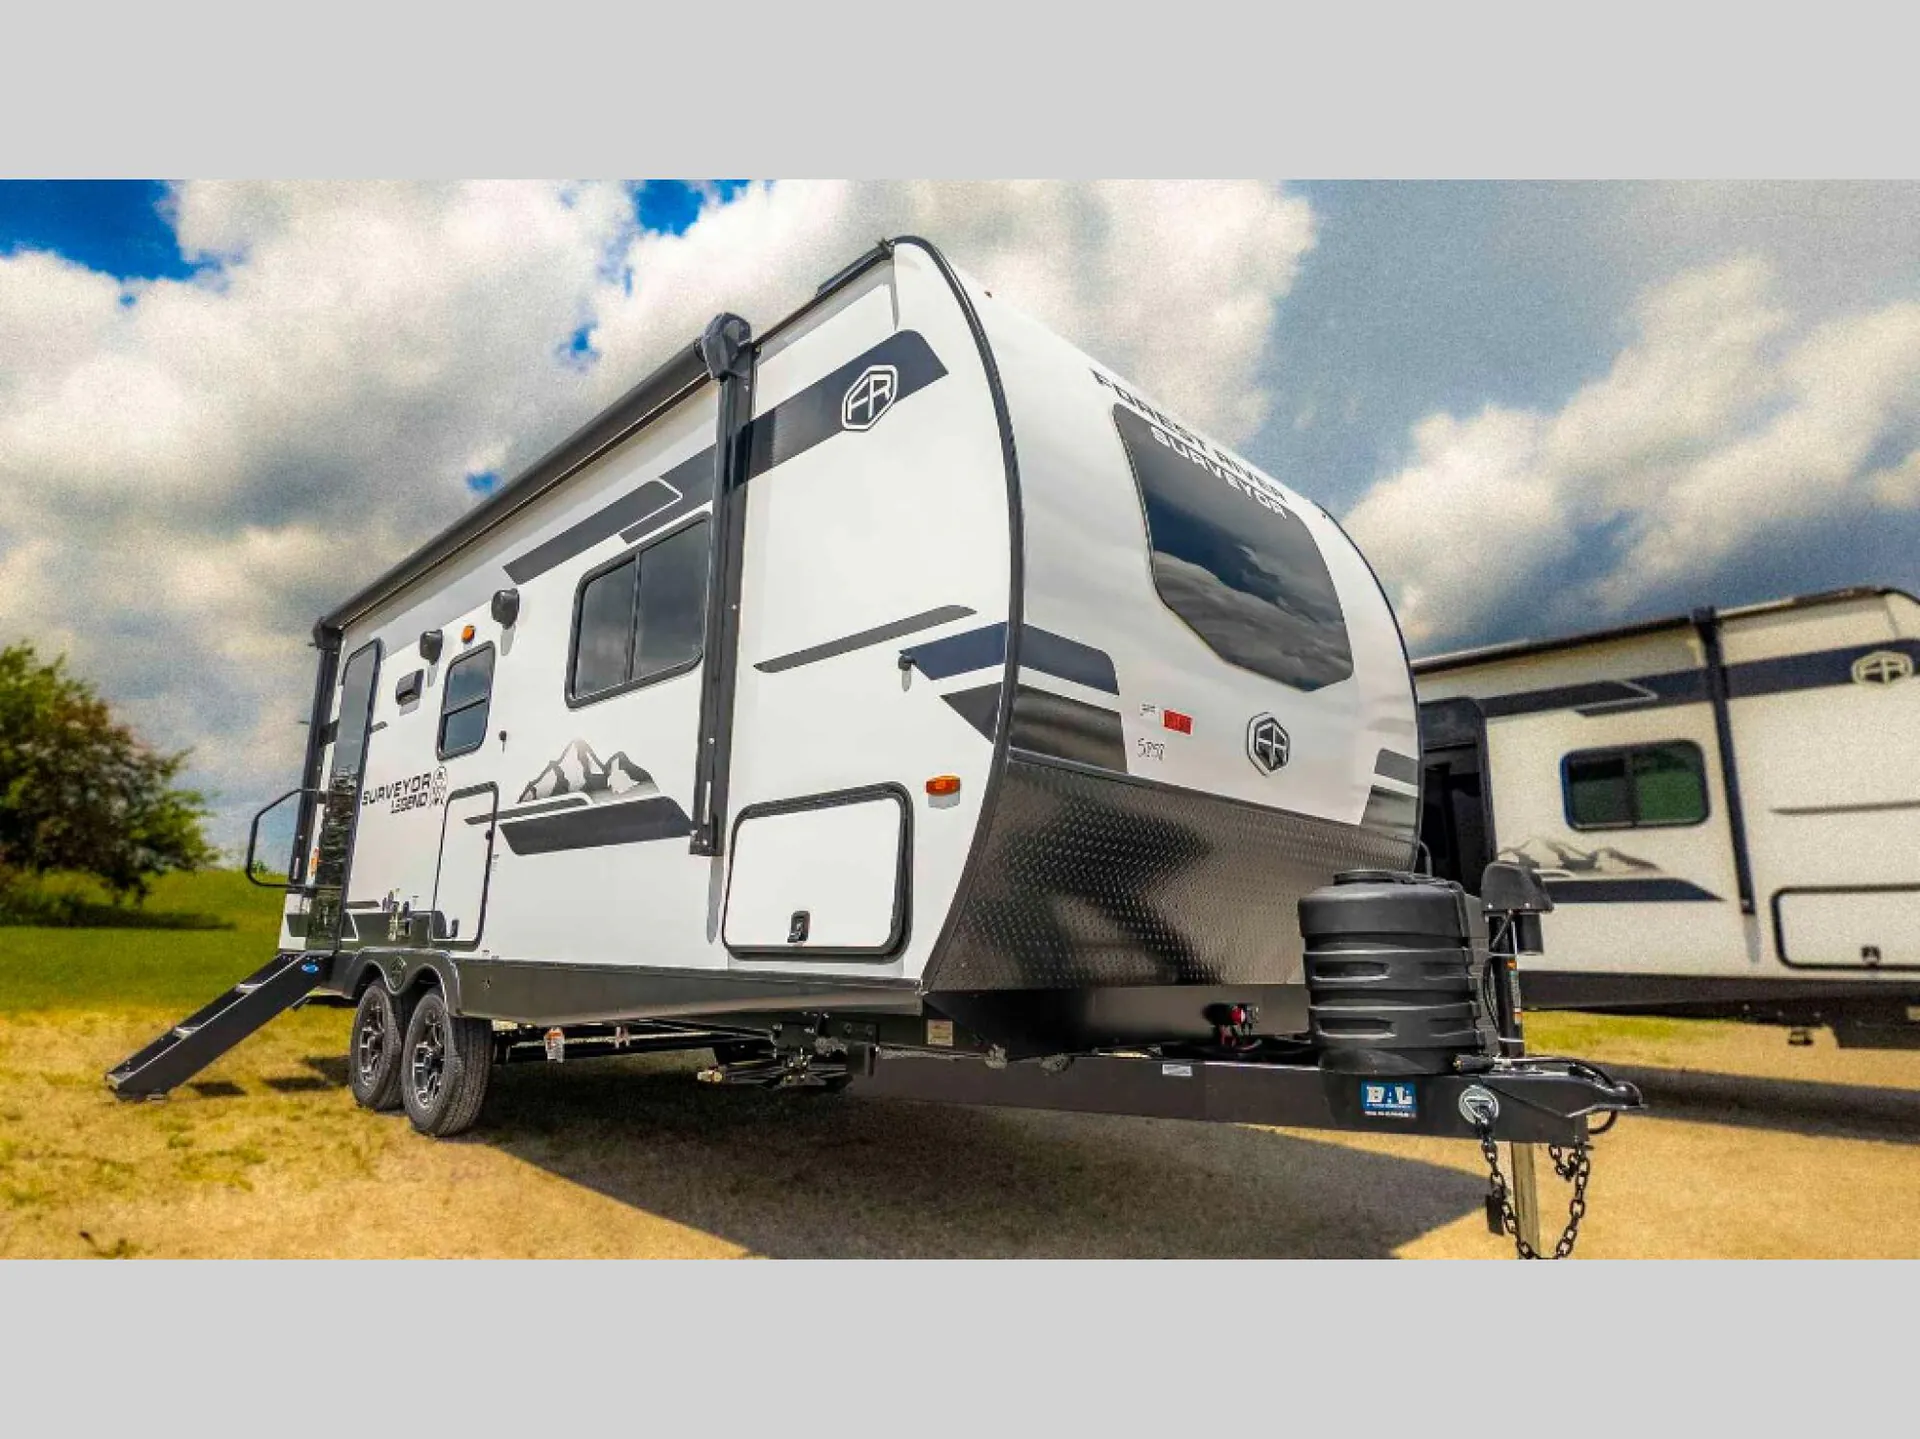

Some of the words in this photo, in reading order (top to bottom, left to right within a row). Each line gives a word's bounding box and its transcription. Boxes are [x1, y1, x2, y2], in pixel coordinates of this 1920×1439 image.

[1090, 367, 1207, 452] FOREST
[1213, 449, 1288, 504] RIVER
[1150, 426, 1287, 520] SURVEYOR
[362, 772, 432, 806] SURVEYOR
[390, 792, 428, 814] LEGEND
